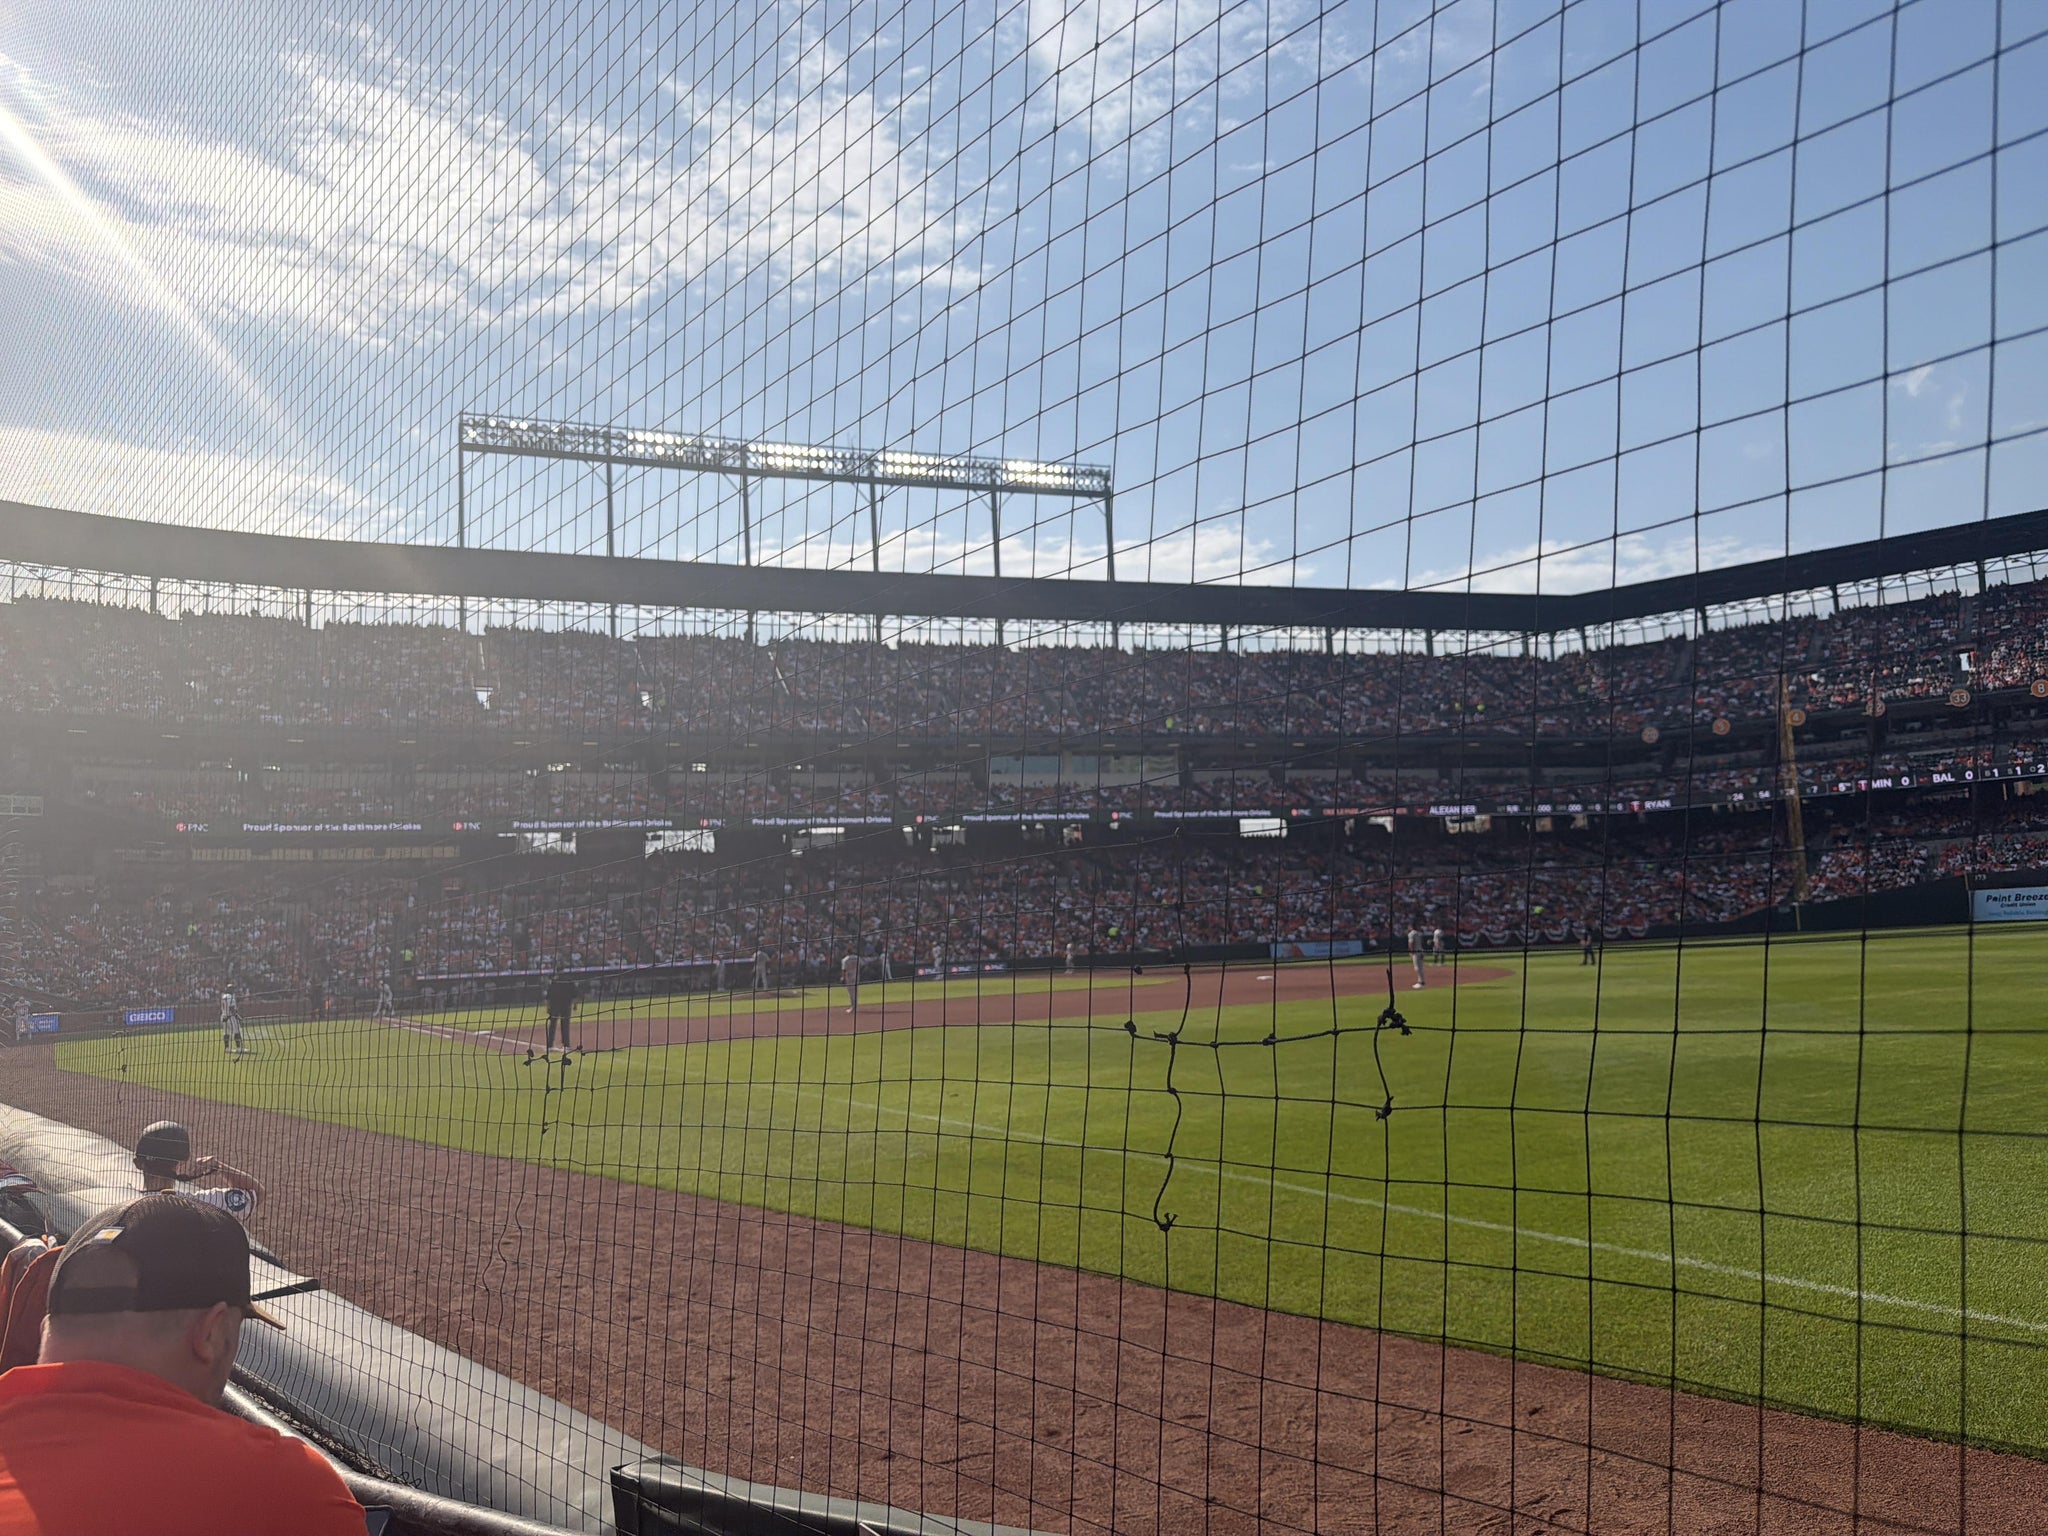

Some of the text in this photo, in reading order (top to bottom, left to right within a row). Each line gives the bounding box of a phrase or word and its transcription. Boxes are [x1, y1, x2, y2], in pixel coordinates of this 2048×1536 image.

[1954, 693, 1967, 703] 33
[1993, 768, 1999, 777] 1
[2015, 766, 2021, 775] 1
[2037, 763, 2045, 773] 2
[1932, 770, 1973, 783] BAL 0
[1872, 776, 1909, 789] MIN 0
[1644, 799, 1671, 810] RYAN
[1430, 805, 1476, 815] ALEXANDER
[513, 821, 538, 829] Proud
[752, 816, 775, 825] Proud
[776, 816, 806, 826] Sponsor
[830, 815, 864, 824] Baltimore
[866, 815, 892, 823] Orioles
[188, 823, 209, 832] PNC
[243, 824, 271, 832] Proud
[129, 1012, 166, 1022] GEICO
